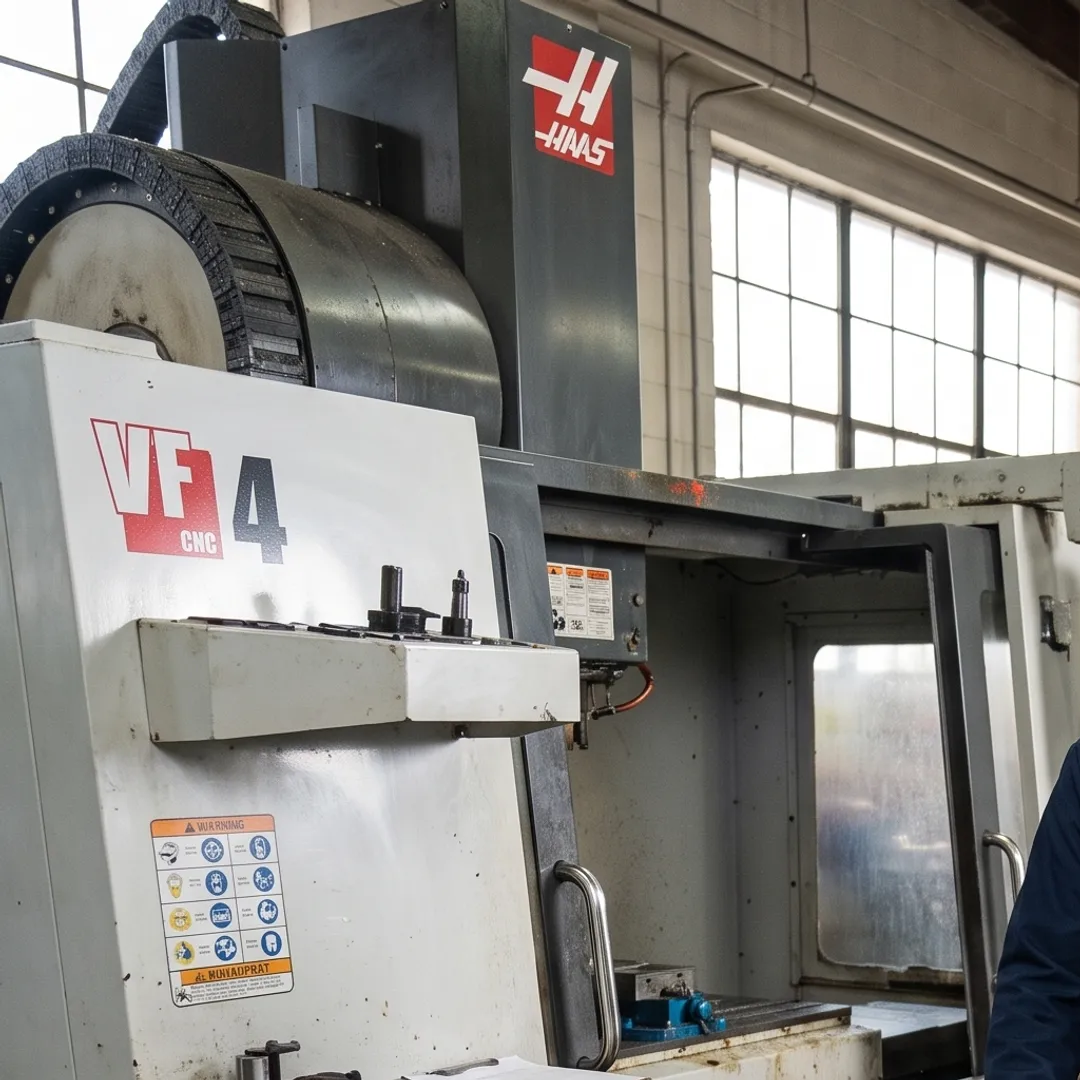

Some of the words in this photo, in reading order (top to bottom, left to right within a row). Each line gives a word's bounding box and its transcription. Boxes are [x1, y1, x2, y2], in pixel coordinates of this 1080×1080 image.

[535, 121, 614, 166] HAAS
[90, 418, 193, 519] VF
[232, 455, 288, 564] 4
[180, 529, 218, 554] CNC
